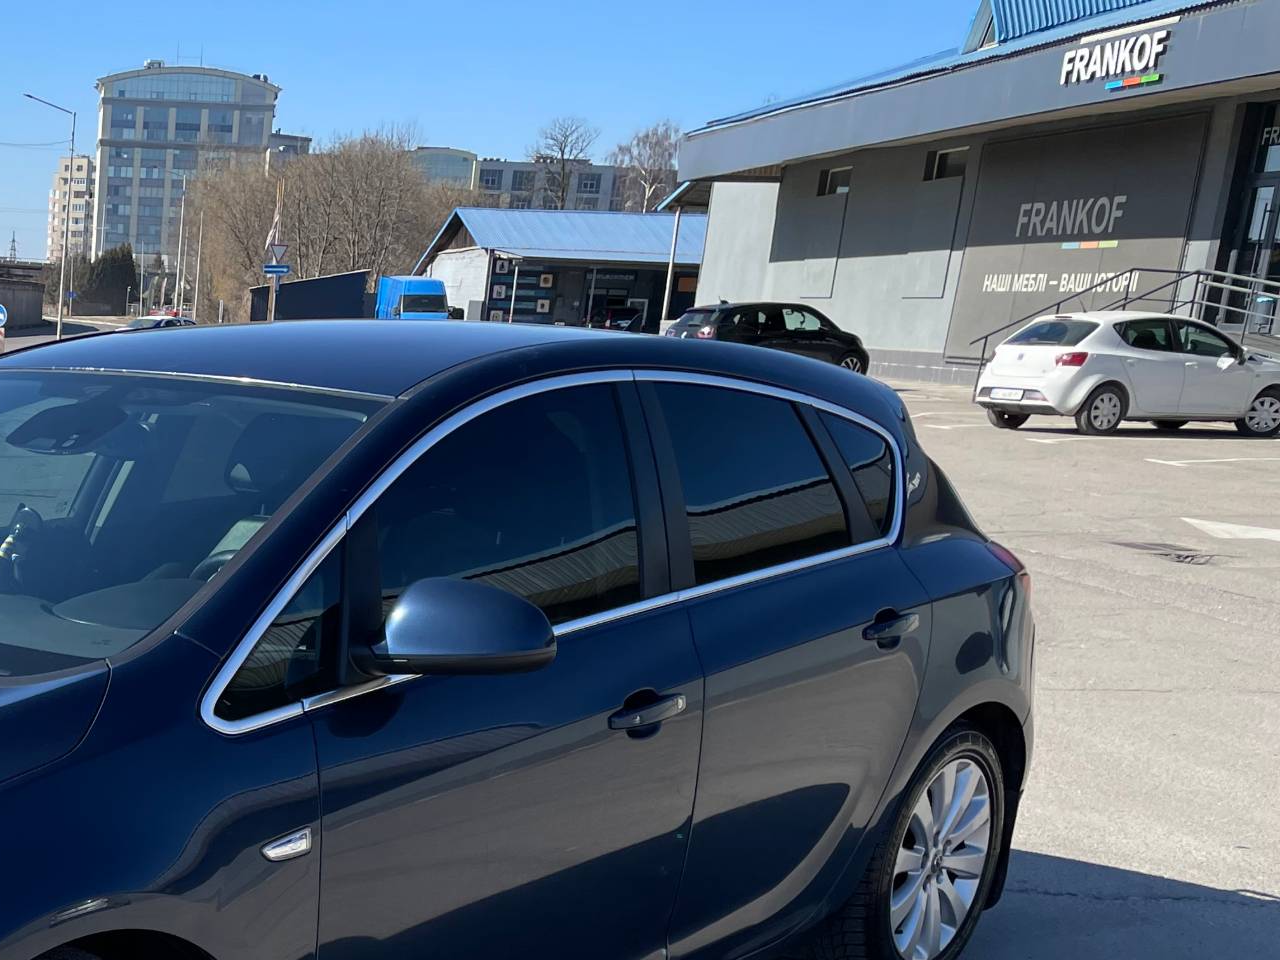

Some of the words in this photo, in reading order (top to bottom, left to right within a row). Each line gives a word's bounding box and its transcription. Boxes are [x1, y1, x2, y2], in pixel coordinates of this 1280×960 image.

[1060, 30, 1168, 85] FRANKOF
[1261, 126, 1280, 145] FR
[1016, 195, 1127, 237] FRANKOF
[983, 274, 1012, 292] НАШІ
[1012, 273, 1048, 292] МЕБЛІ
[1059, 272, 1092, 292] ВАШІ
